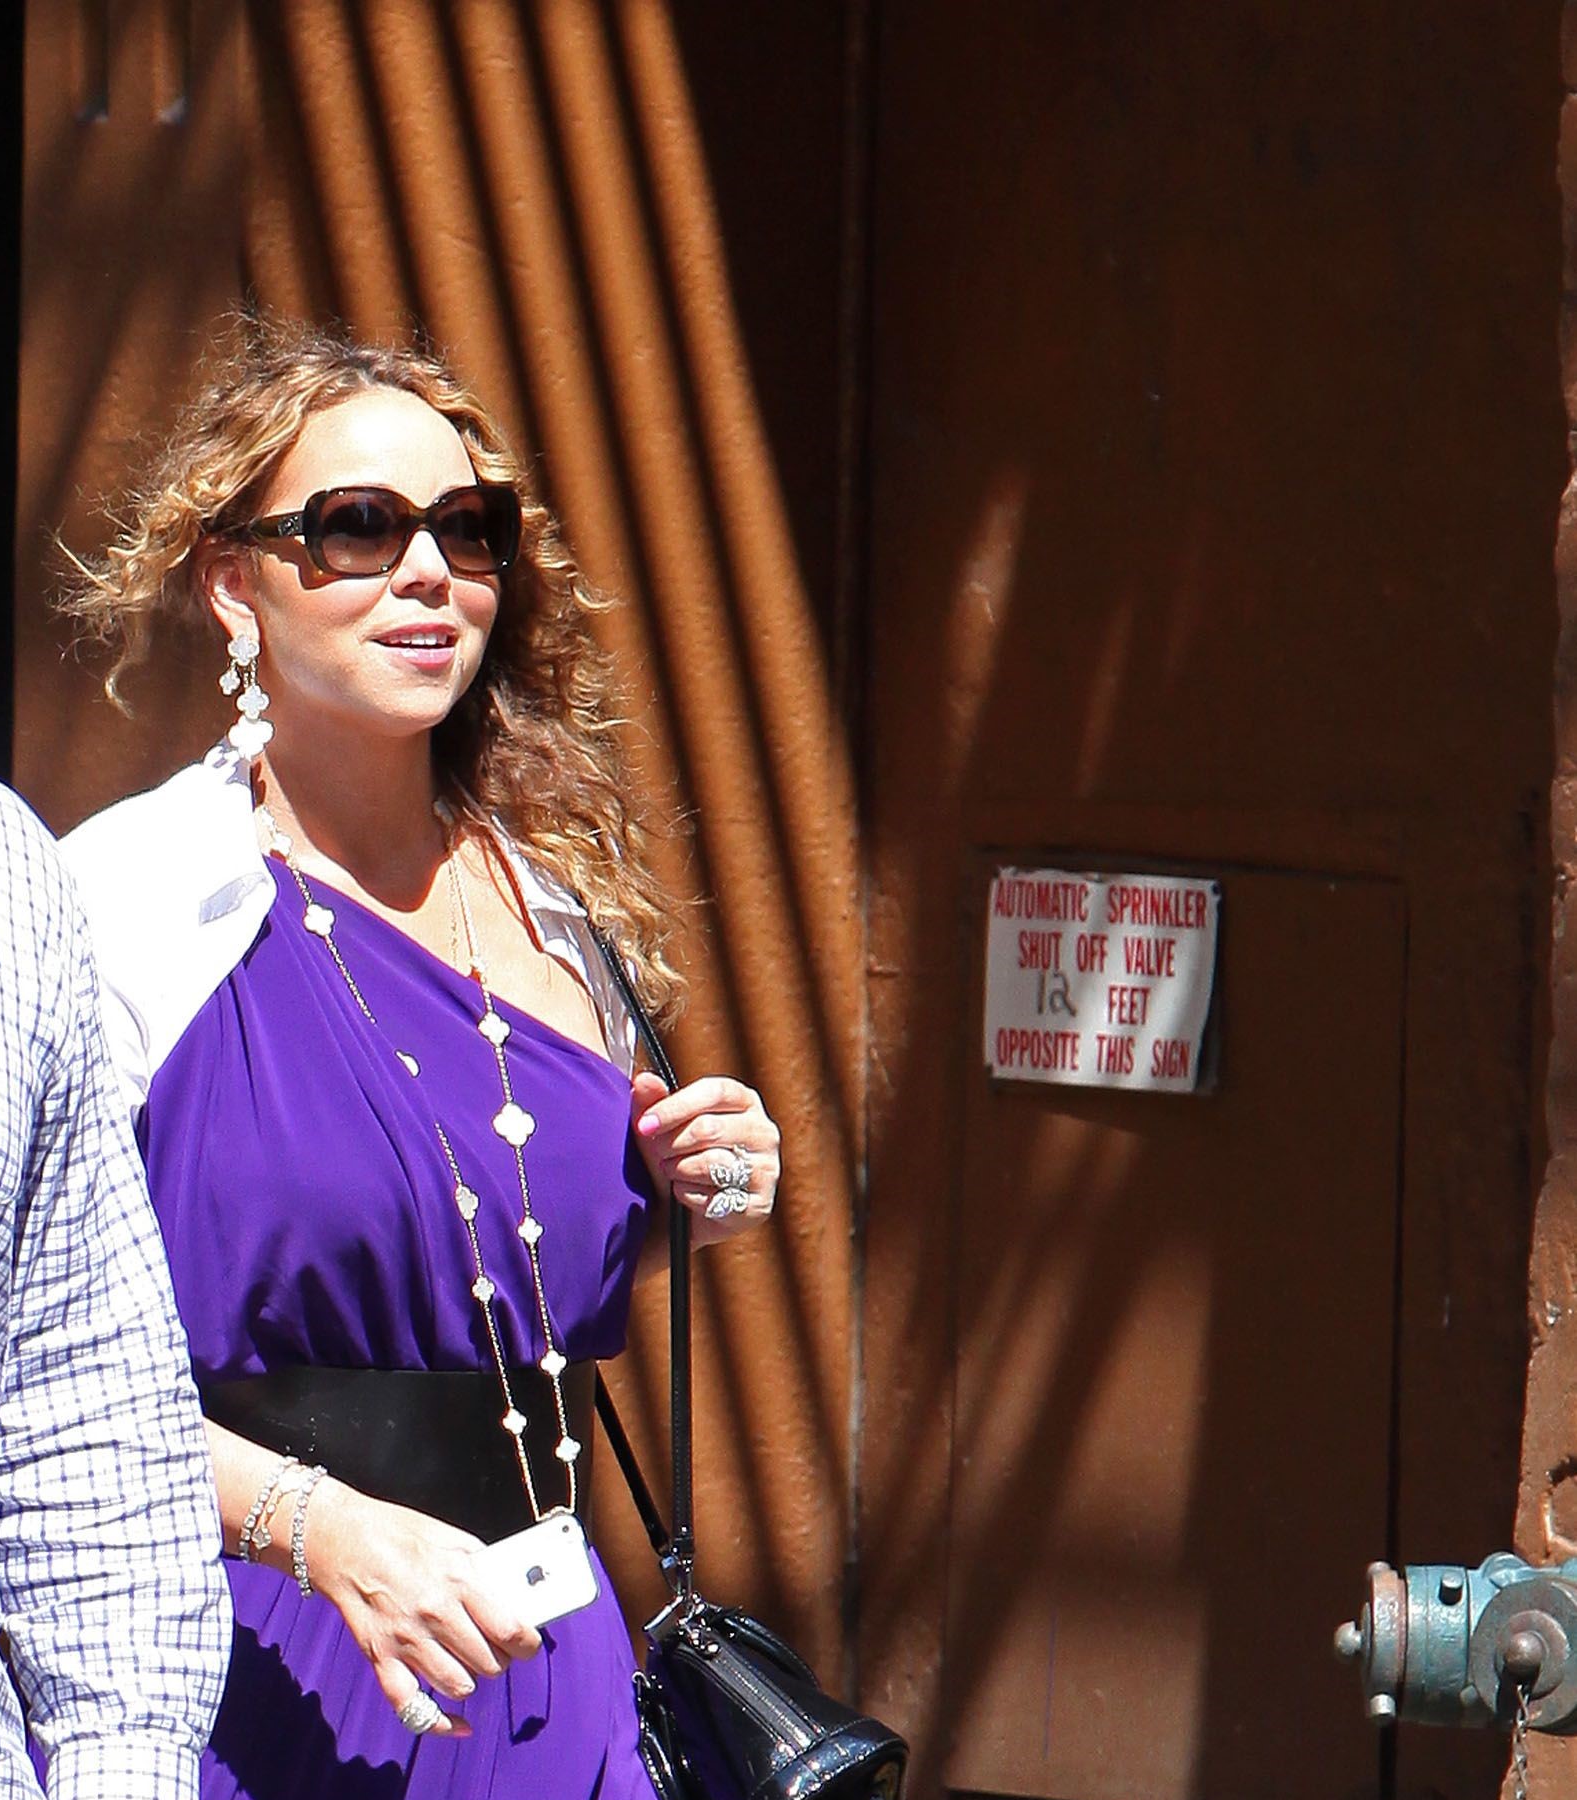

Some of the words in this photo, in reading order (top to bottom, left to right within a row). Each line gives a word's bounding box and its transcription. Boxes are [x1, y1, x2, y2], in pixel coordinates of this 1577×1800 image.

[995, 880, 1090, 922] AUTOMATIC
[1107, 884, 1207, 929] SPRINKLER
[1018, 931, 1063, 970] SHUT
[1076, 933, 1109, 973] OFF
[1124, 936, 1177, 978] VALVE
[1036, 972, 1077, 1018] 12
[1107, 984, 1151, 1025] FEET
[996, 1027, 1080, 1071] OPPOSITE
[1095, 1034, 1135, 1075] THIS
[1151, 1041, 1191, 1078] SIGN
